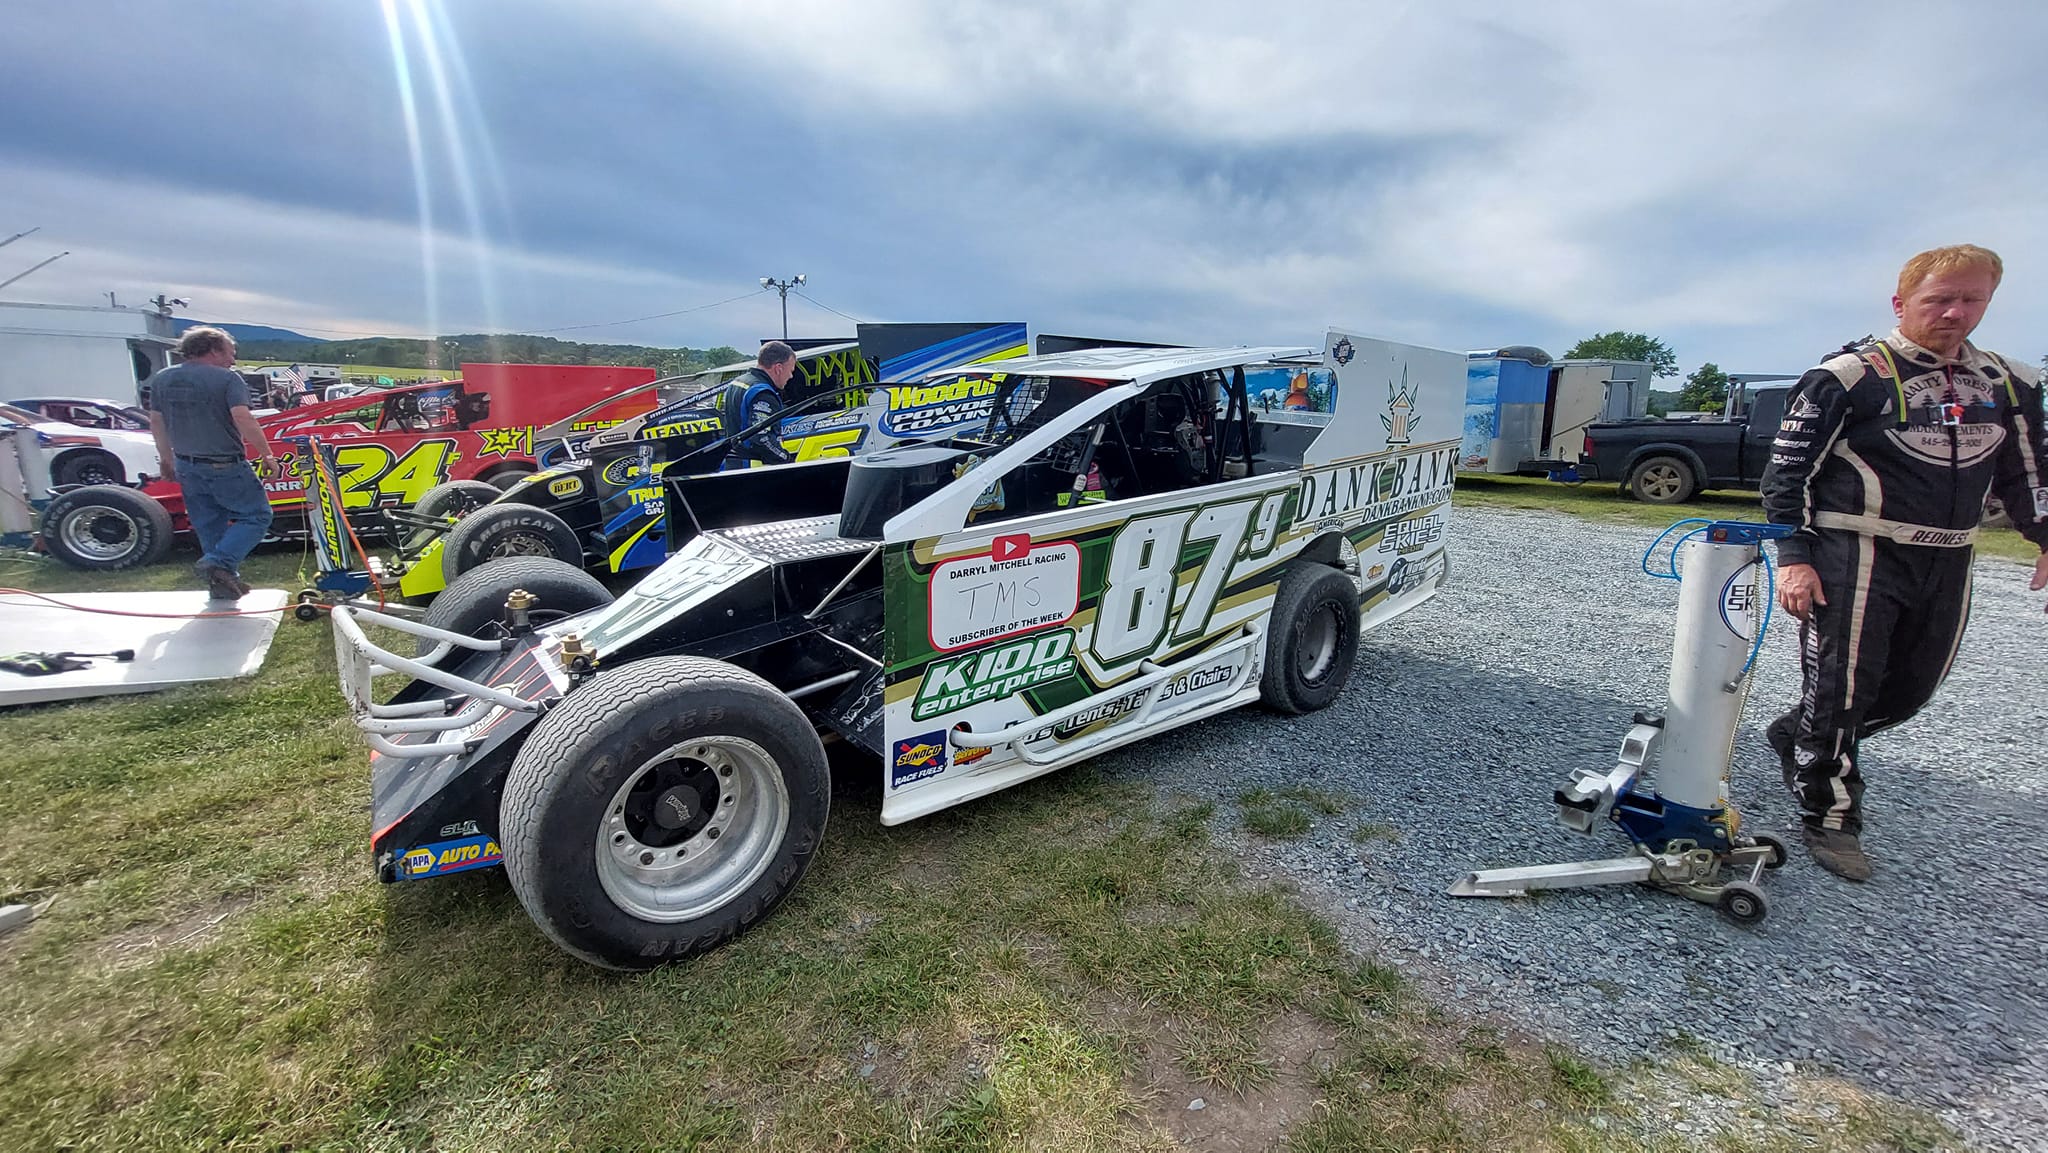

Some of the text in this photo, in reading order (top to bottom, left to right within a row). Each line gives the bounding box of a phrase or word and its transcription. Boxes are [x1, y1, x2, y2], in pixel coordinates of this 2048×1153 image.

[1953, 376, 1994, 397] OREST
[892, 398, 996, 424] POWDE
[893, 407, 993, 433] COATIN
[553, 481, 579, 493] BERT
[1294, 447, 1461, 523] DANK BANK
[469, 517, 557, 557] AMERICAN
[1383, 514, 1446, 538] EQUAL
[1377, 526, 1443, 553] SKIES
[949, 552, 1067, 580] DARRYL MITCHELL RACING
[958, 576, 1042, 622] TMS
[1727, 597, 1755, 611] SK
[948, 611, 1064, 645] SUBSCRIBER OF THE WEEK
[921, 632, 1072, 700] KIDD
[917, 661, 1073, 717] enterprise
[1175, 678, 1188, 695] &
[1190, 665, 1232, 691] Chairs
[898, 744, 943, 765] SUNOCO
[894, 765, 943, 786] RACE FUELS
[437, 844, 481, 866] AUTO
[483, 841, 503, 858] PA
